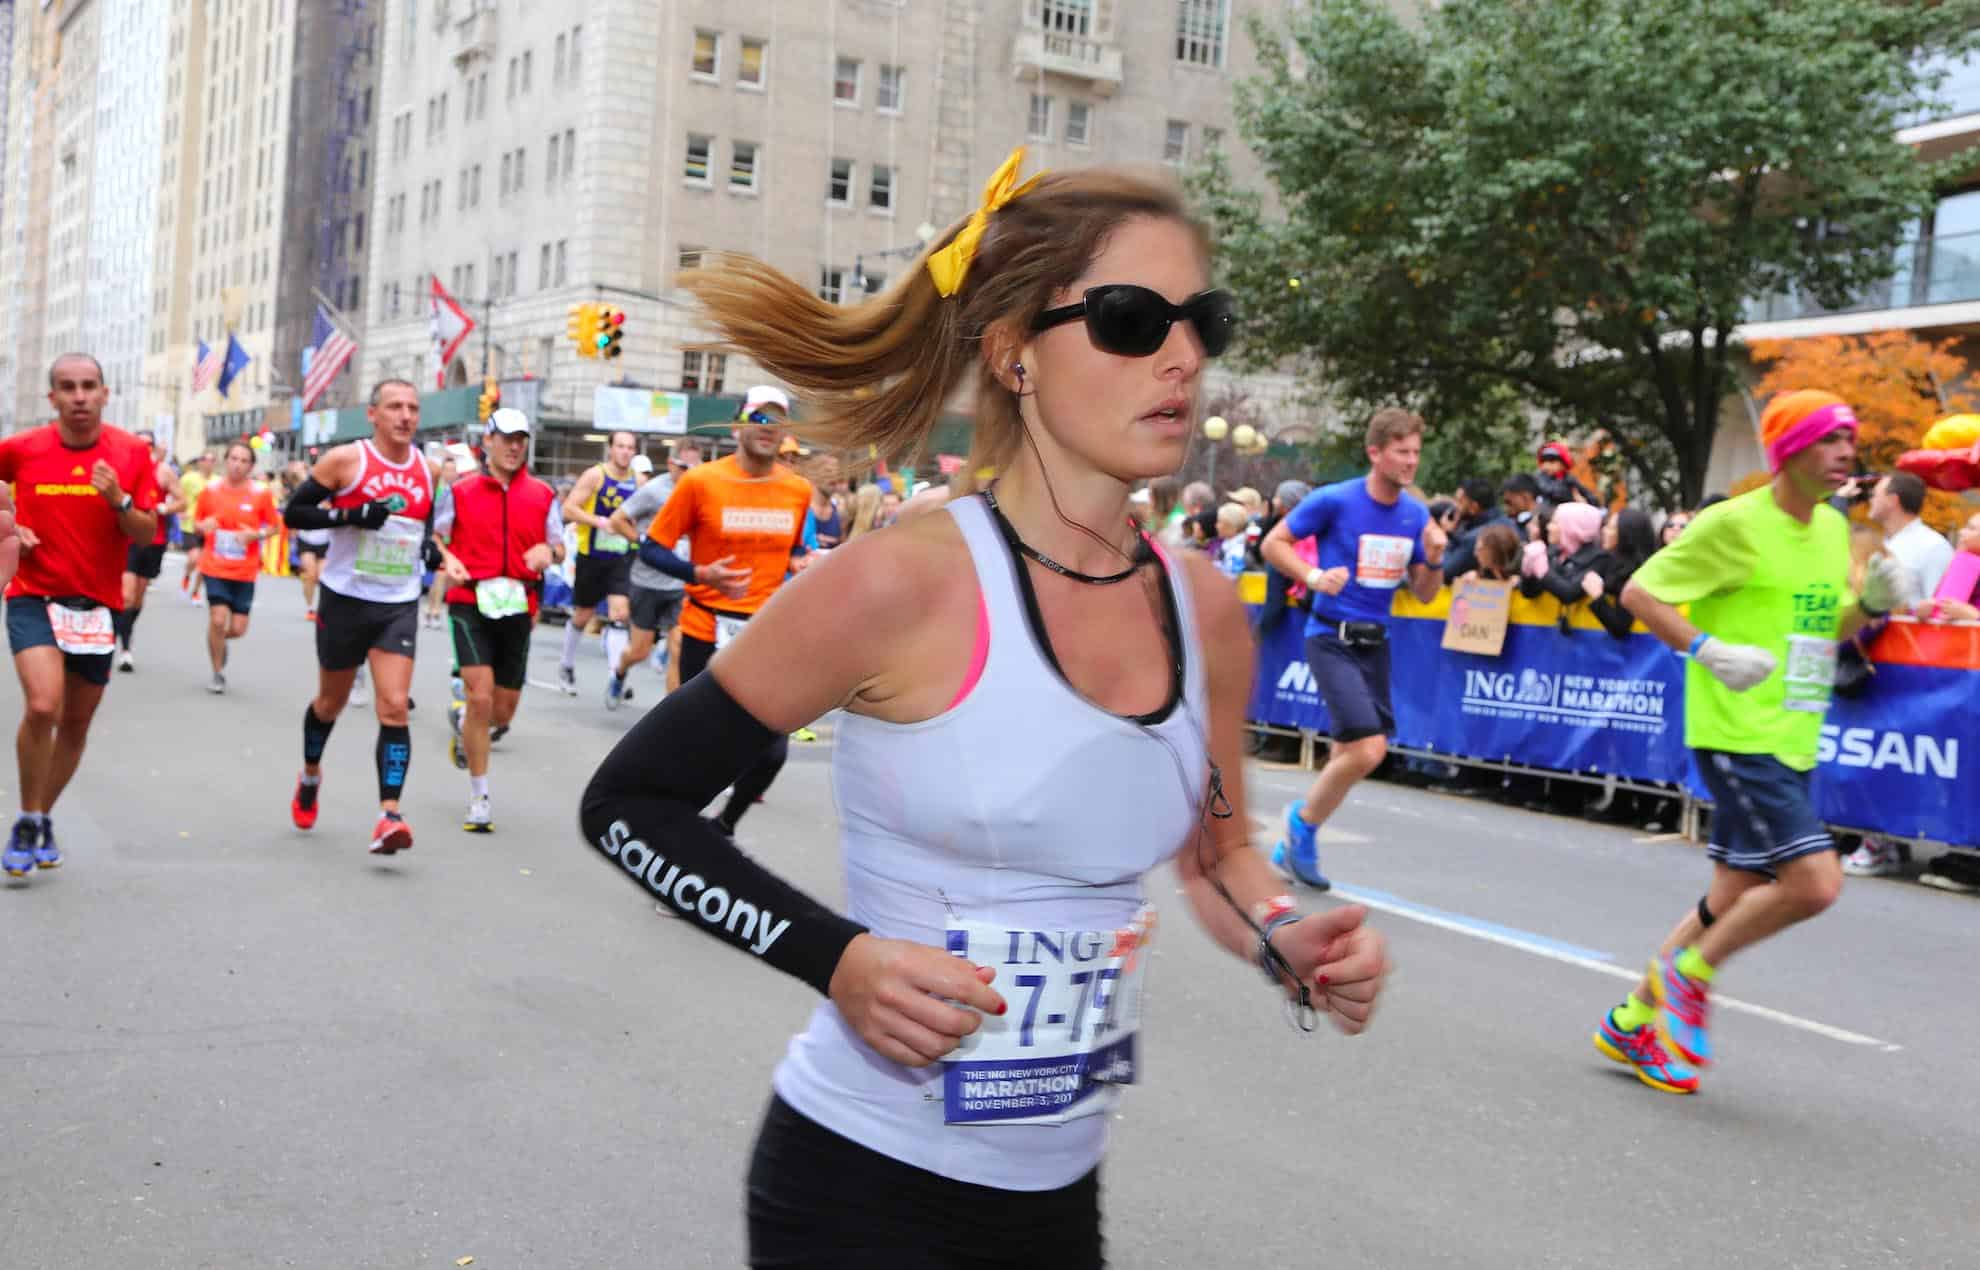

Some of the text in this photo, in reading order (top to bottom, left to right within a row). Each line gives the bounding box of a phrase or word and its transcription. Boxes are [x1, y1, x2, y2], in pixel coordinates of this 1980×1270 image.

[362, 471, 425, 503] ITALIA
[1464, 669, 1515, 701] ING
[1564, 675, 1594, 690] NEW
[1631, 679, 1666, 695] CITY
[1562, 689, 1664, 716] MARATHON
[1817, 724, 1958, 779] SSAN
[600, 820, 792, 955] saucony
[1003, 930, 1102, 964] ING
[964, 1074, 1080, 1099] MARATHON
[965, 1064, 1079, 1080] THE ING NEW YORK CITY
[965, 1092, 1073, 1111] NOVEMBER 3, 201
